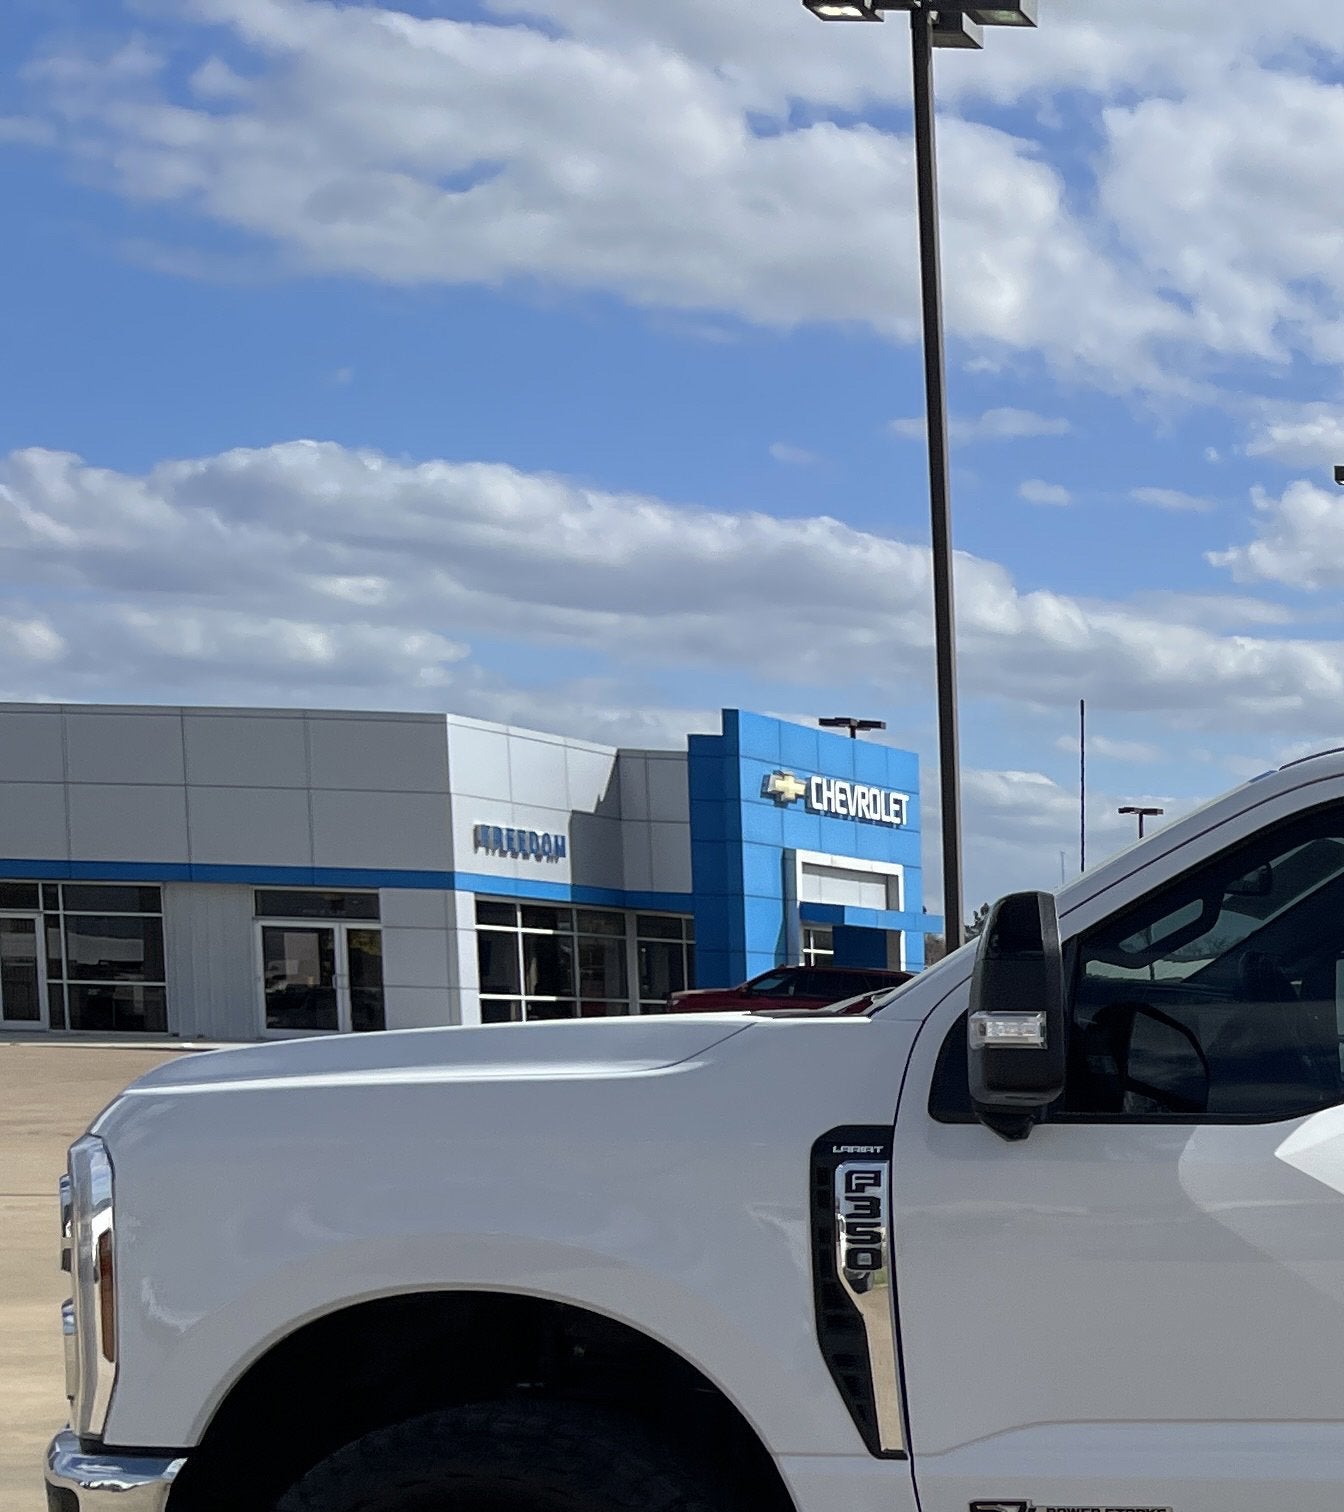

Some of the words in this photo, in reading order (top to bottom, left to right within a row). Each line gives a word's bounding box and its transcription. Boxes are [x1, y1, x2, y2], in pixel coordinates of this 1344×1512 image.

[809, 776, 909, 826] CHEVROLET
[476, 824, 566, 858] FREEDOM
[832, 1145, 884, 1154] LARIAT
[845, 1170, 883, 1270] F350
